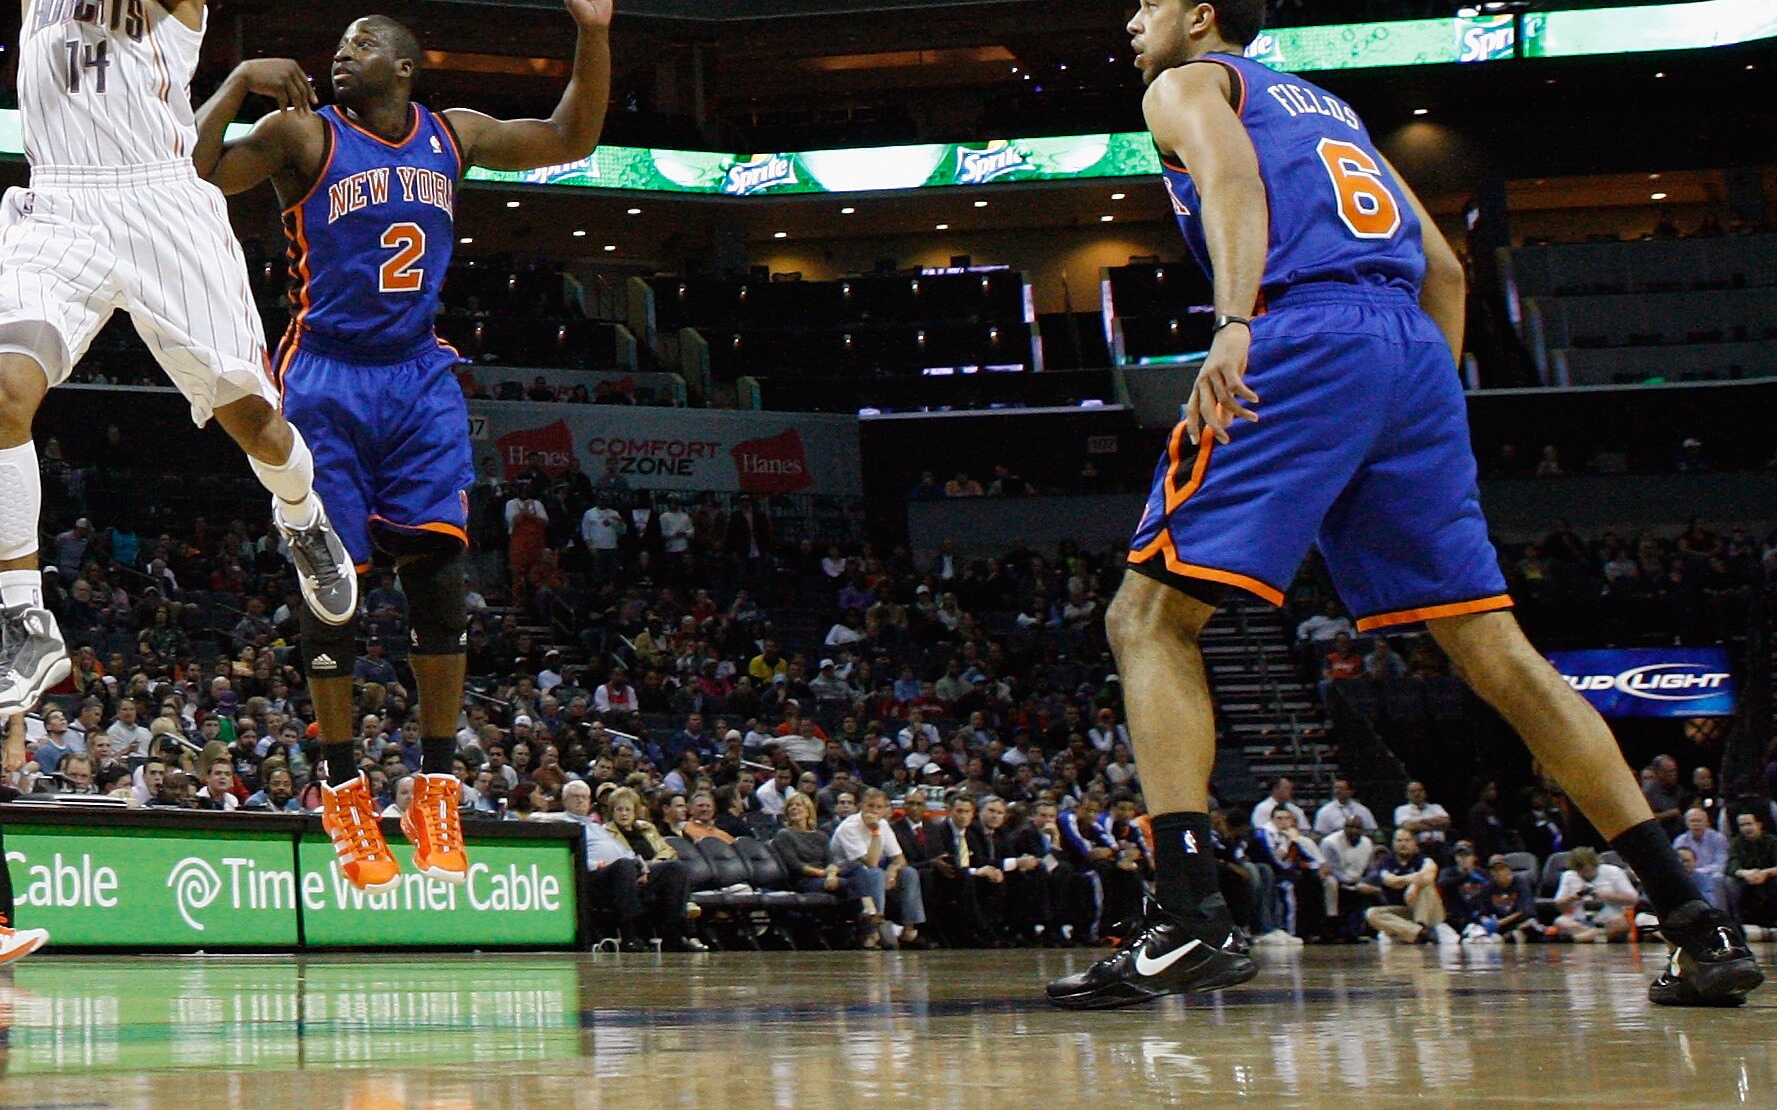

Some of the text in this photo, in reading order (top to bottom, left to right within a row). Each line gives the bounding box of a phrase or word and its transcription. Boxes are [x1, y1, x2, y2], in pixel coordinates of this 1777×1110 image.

[65, 39, 111, 95] 14
[1267, 83, 1361, 131] FIELDS
[327, 168, 390, 225] NEW
[725, 156, 789, 196] Sprite
[1316, 137, 1402, 239] 6
[379, 221, 426, 292] 2
[588, 436, 723, 459] COMFORT
[619, 456, 695, 477] ZONE
[742, 452, 803, 475] Hanes
[1562, 673, 1731, 691] UD LIGHT
[5, 851, 118, 908] Cable
[221, 857, 325, 911] Time
[467, 862, 561, 912] Cable
